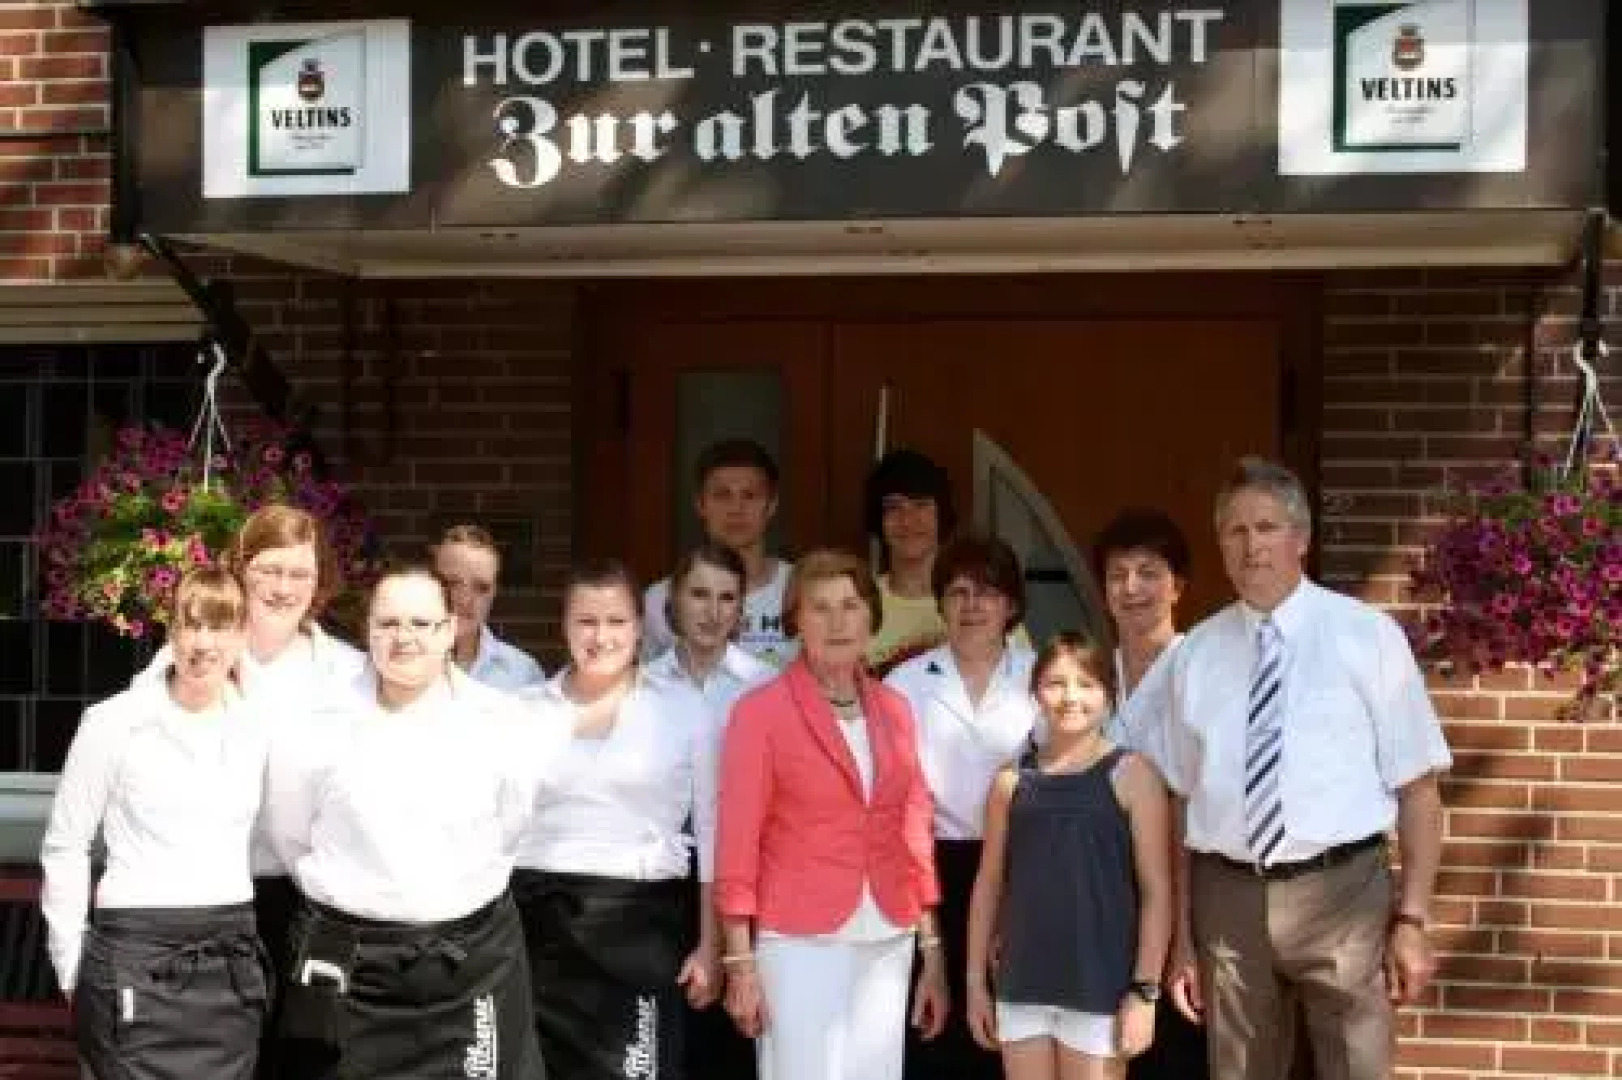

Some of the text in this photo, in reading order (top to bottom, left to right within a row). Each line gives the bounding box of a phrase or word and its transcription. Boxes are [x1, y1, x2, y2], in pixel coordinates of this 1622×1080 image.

[463, 9, 1224, 86] HOTEL RESTAURANT
[1360, 77, 1457, 102] VELTINS
[270, 106, 352, 130] VELTINS
[489, 95, 679, 189] Zur
[694, 89, 934, 164] alten
